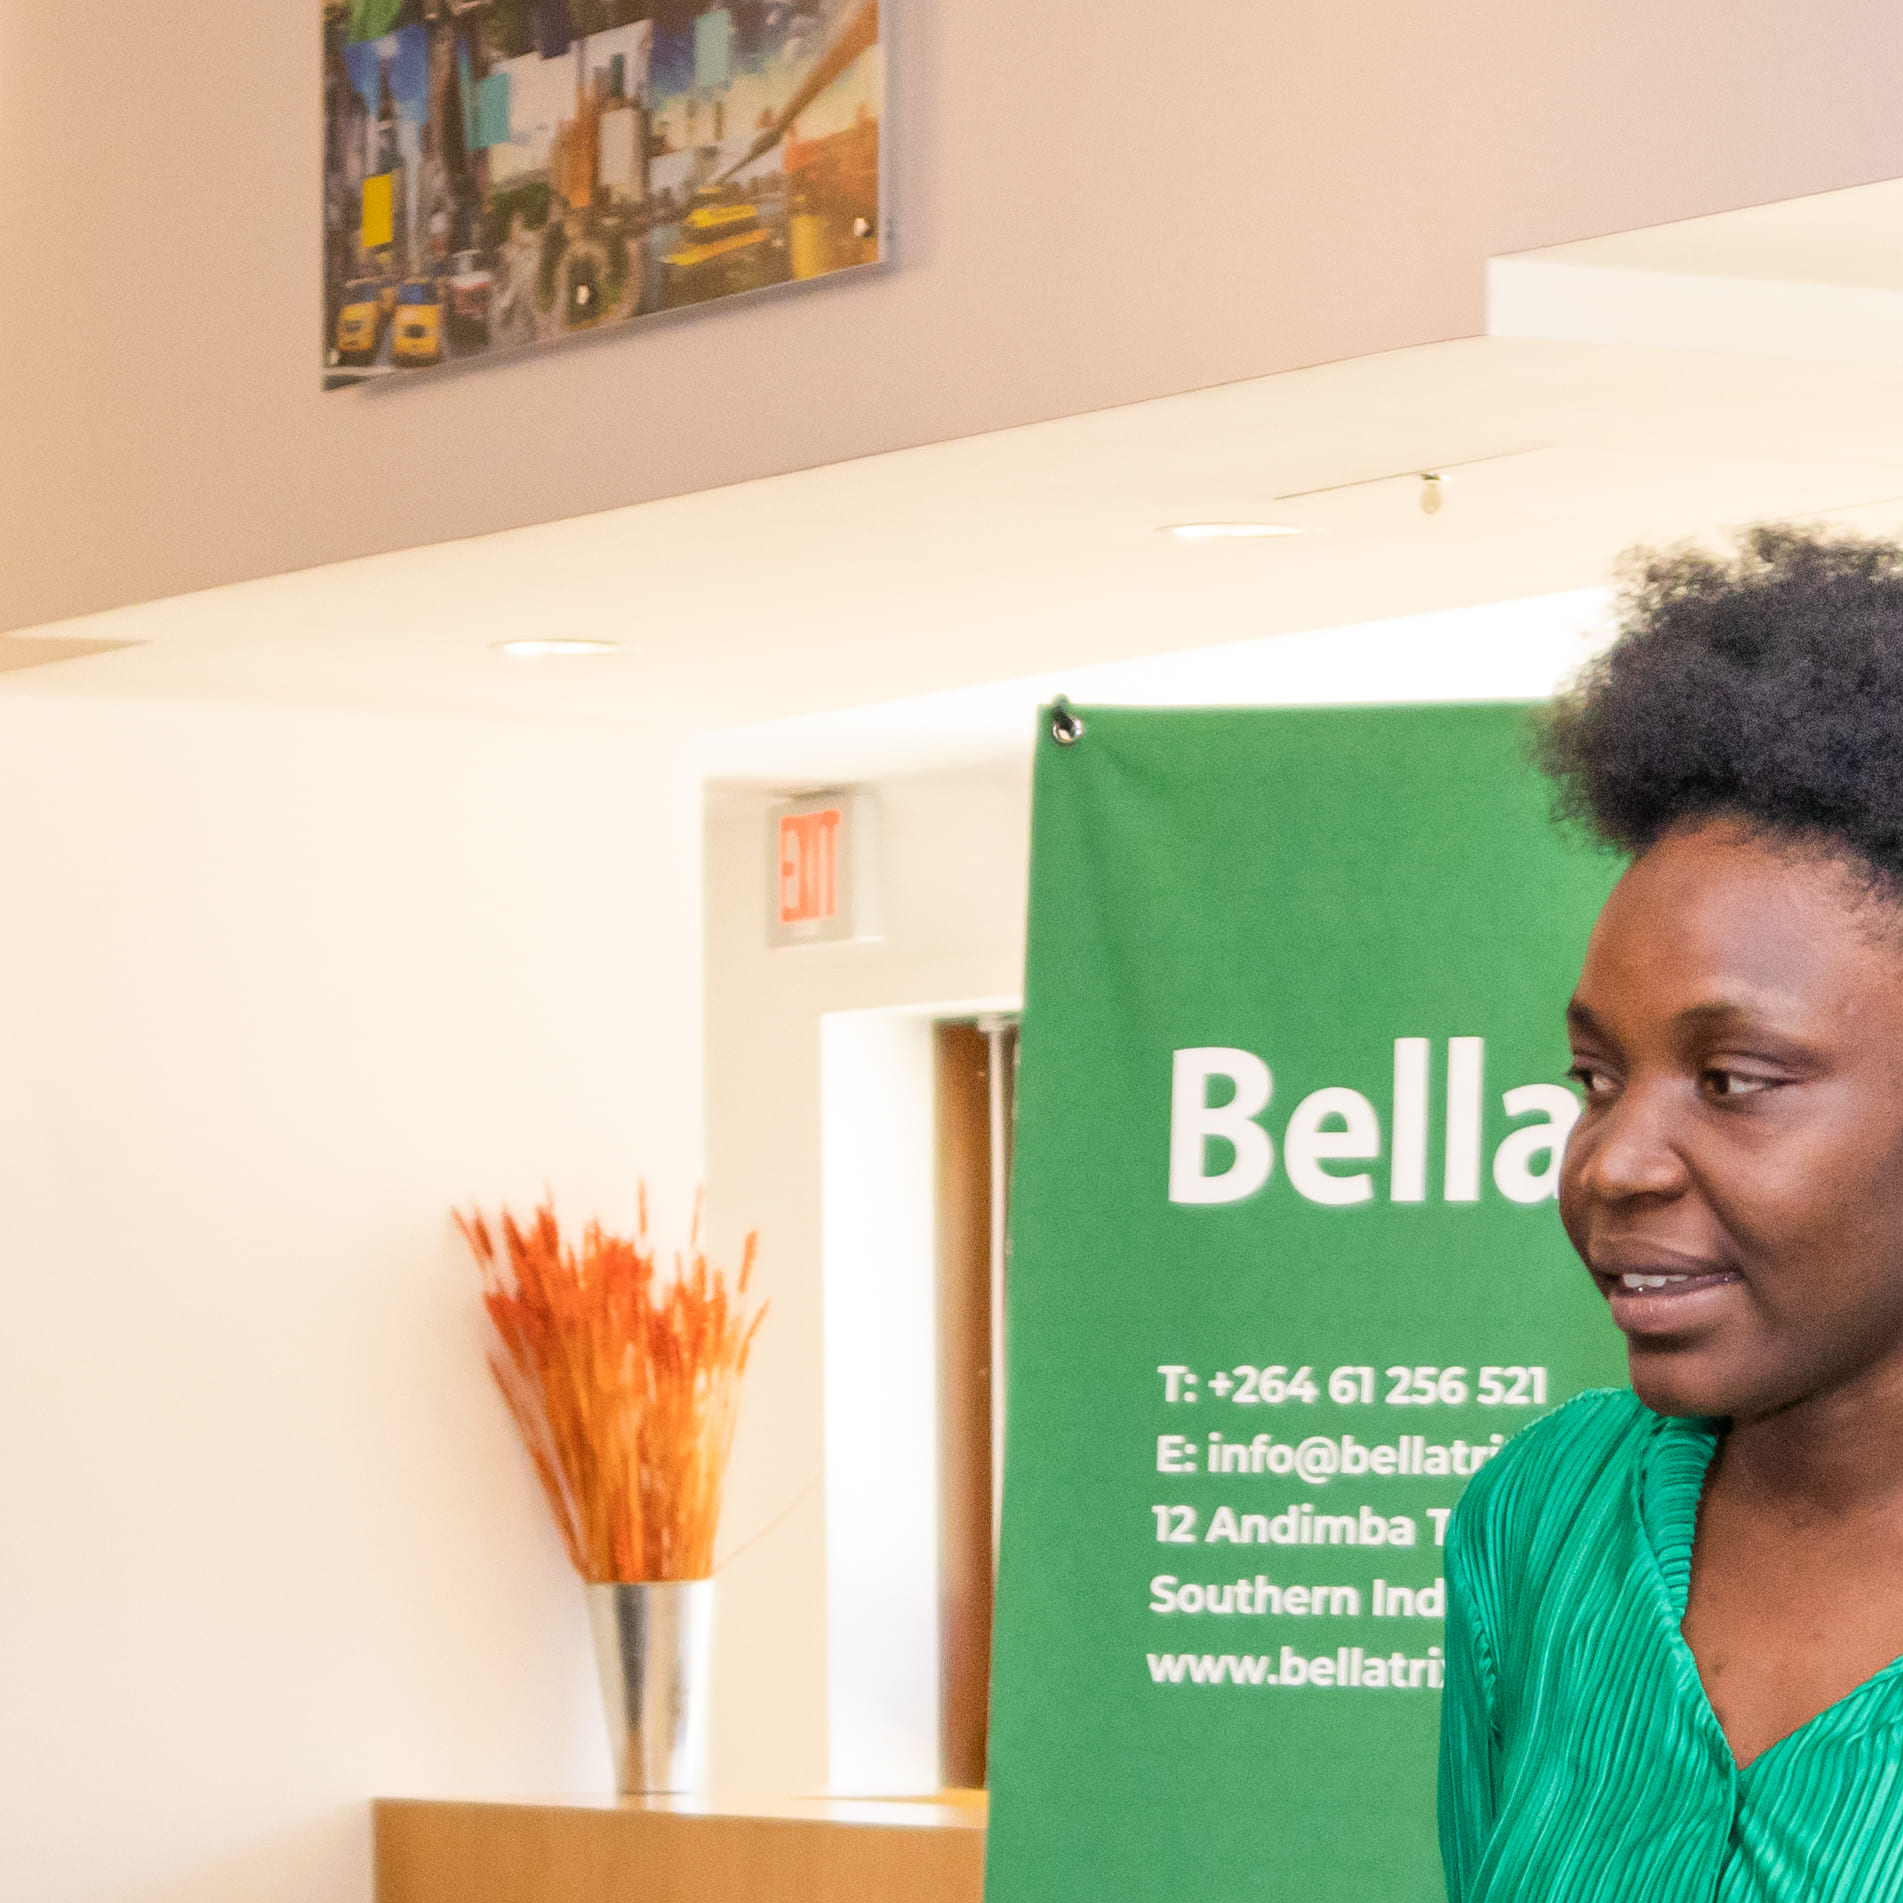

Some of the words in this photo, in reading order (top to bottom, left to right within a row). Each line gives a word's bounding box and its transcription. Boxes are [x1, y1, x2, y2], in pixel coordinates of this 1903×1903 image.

[1167, 1035, 1584, 1205] Bella
[1157, 1365, 1198, 1403] T:
[1208, 1365, 1319, 1404] +264
[1328, 1366, 1375, 1404] 61
[1384, 1366, 1467, 1404] 256
[1476, 1366, 1548, 1405] 521
[1156, 1434, 1198, 1473] E:
[1151, 1504, 1198, 1543] 12
[1204, 1503, 1417, 1546] Andimba
[1149, 1574, 1360, 1616] Southern
[1372, 1577, 1446, 1618] Ind
[1146, 1645, 1445, 1689] www.bellatri
